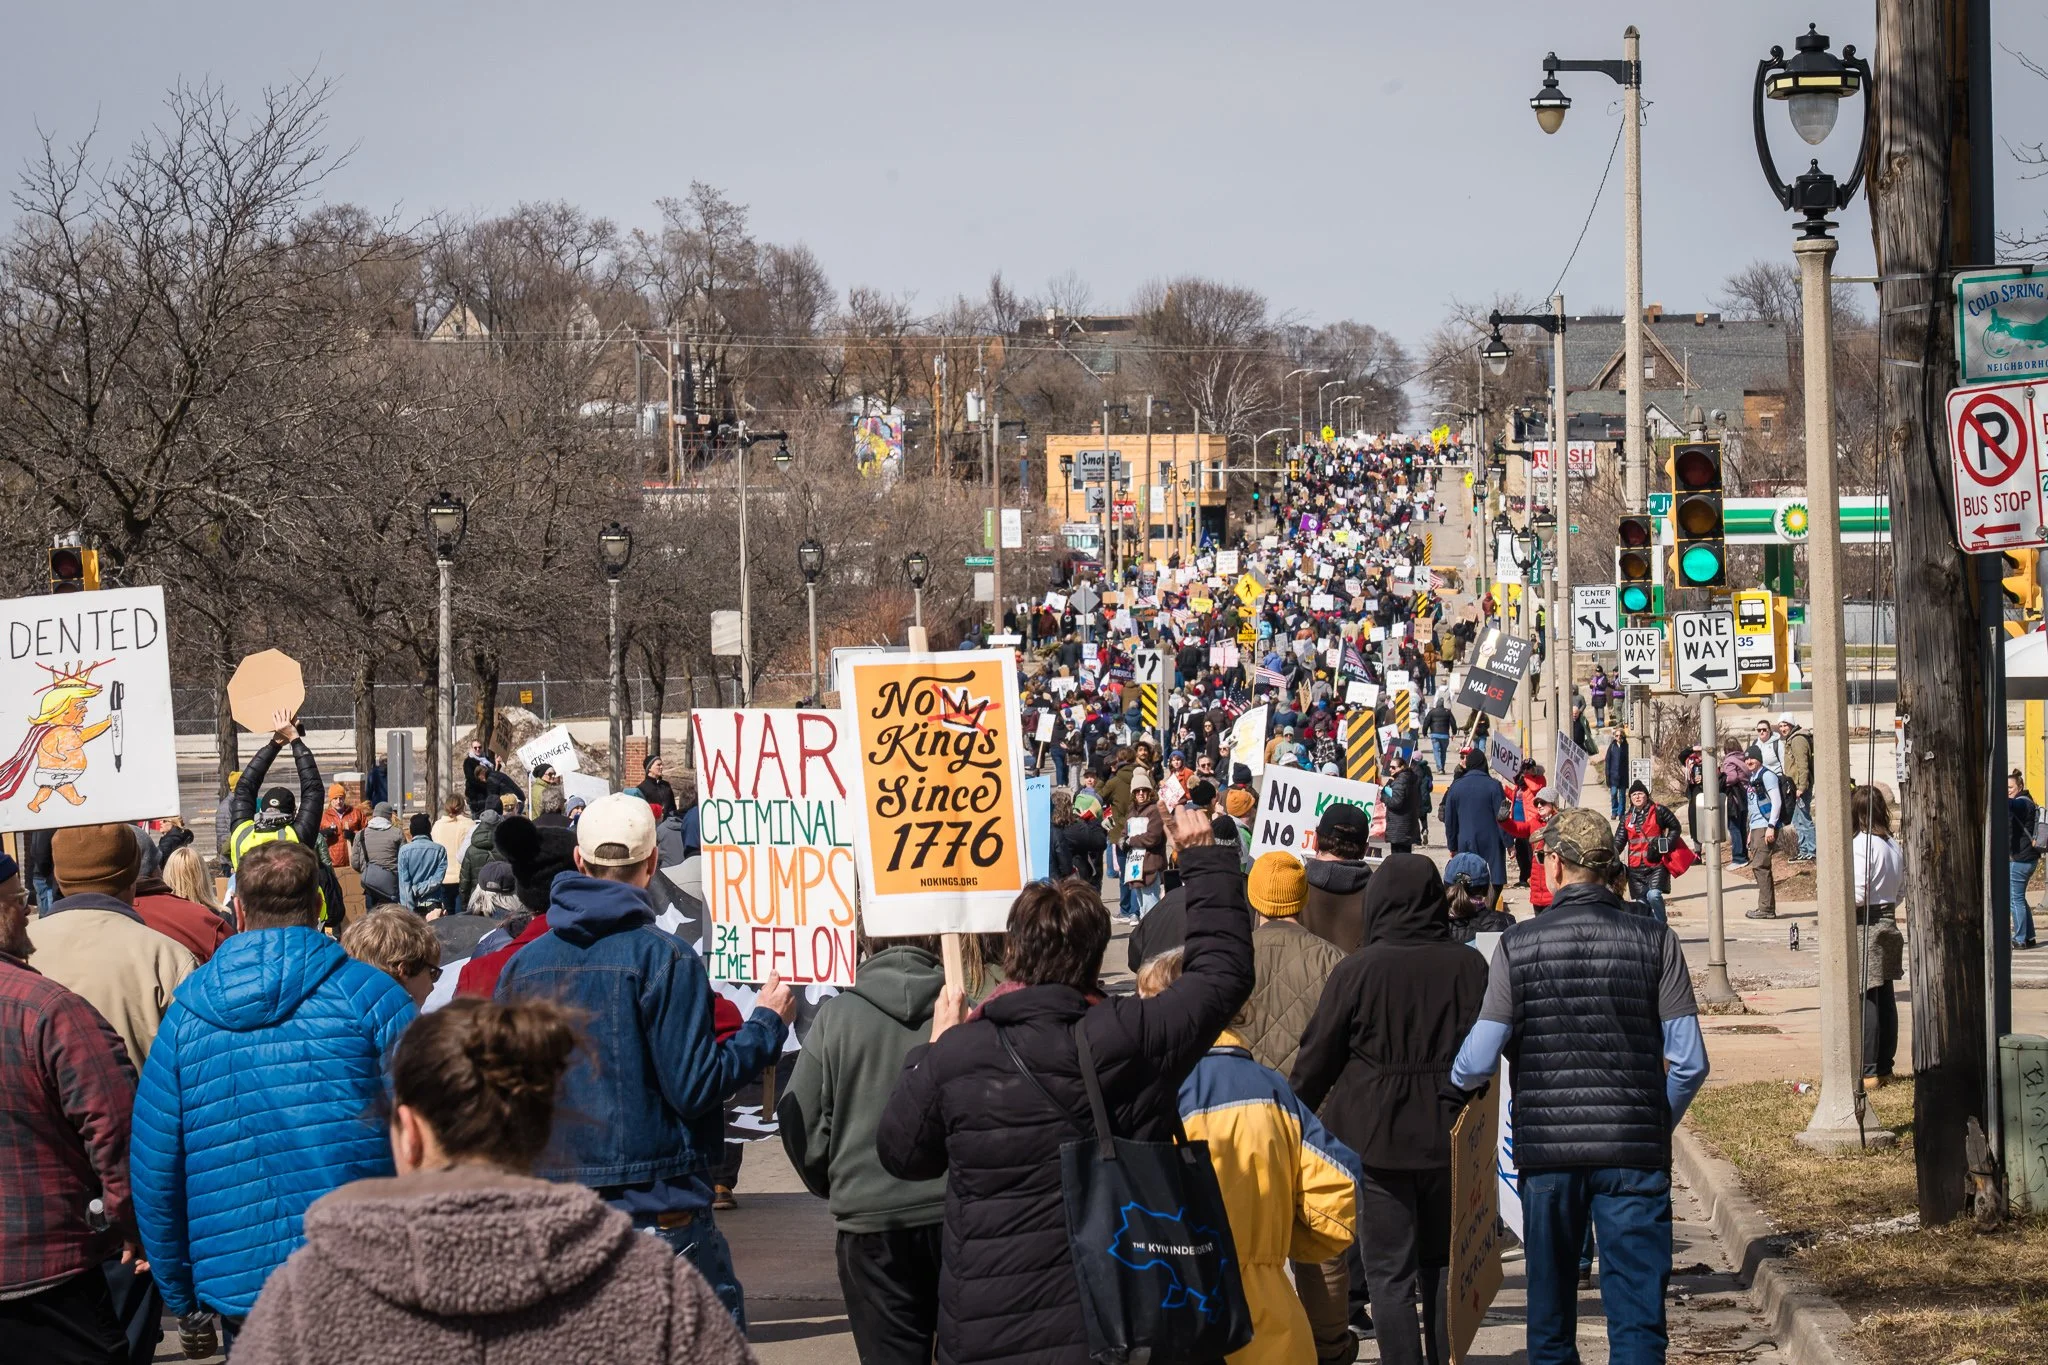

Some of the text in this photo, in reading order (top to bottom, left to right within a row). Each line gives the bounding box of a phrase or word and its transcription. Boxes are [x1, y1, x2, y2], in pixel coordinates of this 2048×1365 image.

[1968, 283, 2044, 317] COLD SPRING
[1963, 490, 2032, 517] BUS STOP
[1579, 589, 1611, 597] CENTER
[10, 608, 158, 660] DENTED
[1624, 633, 1655, 646] ONE
[1683, 617, 1727, 638] ONE
[1505, 639, 1527, 651] NOT
[1507, 648, 1520, 657] ON
[1585, 640, 1606, 648] ONLY
[1683, 639, 1729, 660] WAY
[1737, 636, 1754, 647] 35
[1503, 655, 1519, 664] MY
[1624, 648, 1656, 661] WAY
[1491, 660, 1520, 675] WATCH
[871, 670, 976, 720] No
[1468, 679, 1505, 701] MALICE
[692, 712, 847, 800] WAR
[868, 722, 1003, 774] Kings
[876, 771, 1004, 818] Since
[1268, 780, 1302, 814] NO
[701, 798, 853, 847] CRIMINAL
[1262, 819, 1295, 847] NO
[886, 816, 1005, 873] 1776
[702, 845, 855, 928] TRUMPS
[920, 876, 979, 888] NOKINGS.ORG
[716, 924, 740, 953] 34
[703, 926, 856, 985] TIME FELON
[1132, 1241, 1146, 1249] THE
